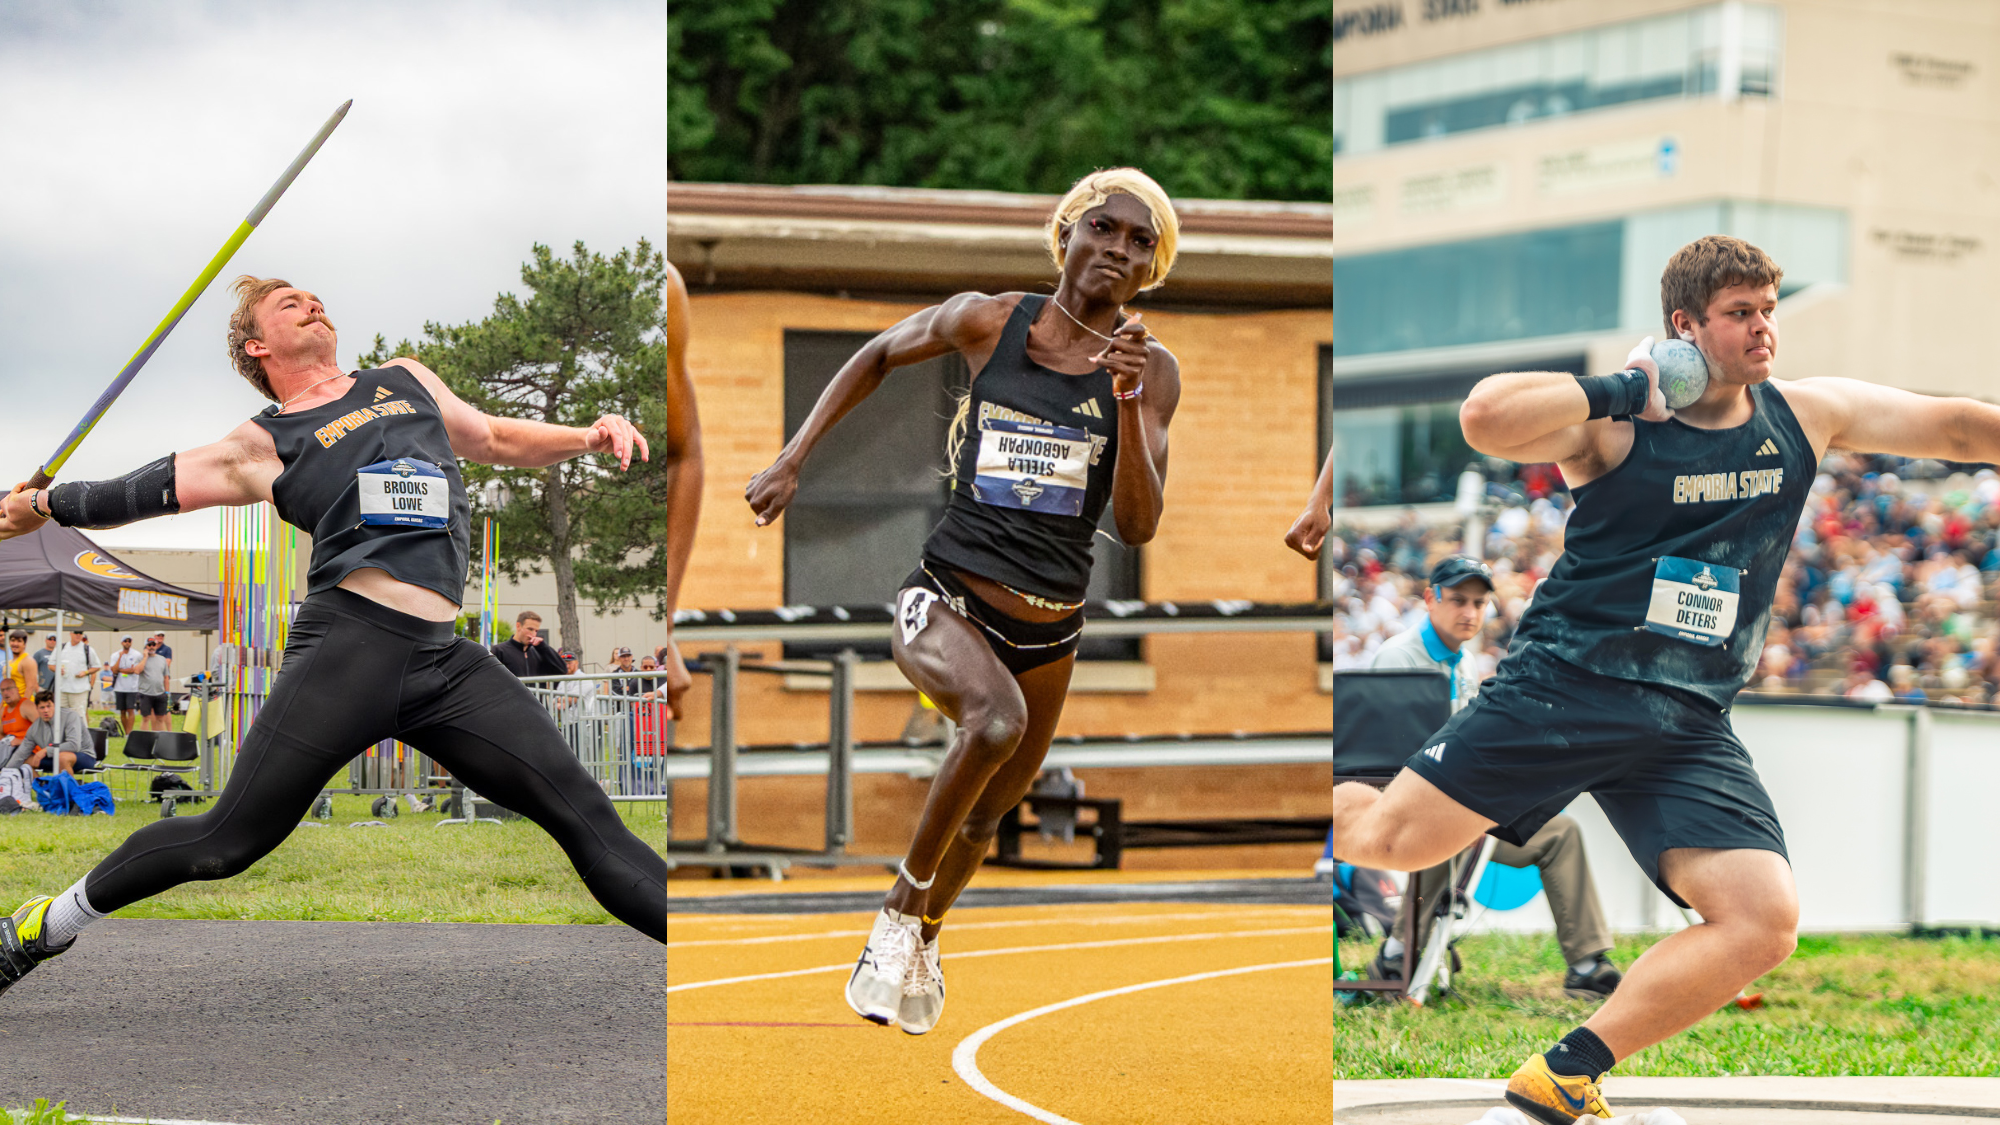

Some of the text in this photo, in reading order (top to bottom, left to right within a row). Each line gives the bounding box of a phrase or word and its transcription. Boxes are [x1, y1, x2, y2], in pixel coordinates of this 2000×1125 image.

[1671, 378, 1686, 395] 18
[314, 400, 417, 449] EMPORIA STATE
[998, 436, 1071, 460] AGBOKPAH
[1008, 457, 1056, 477] STELLA
[384, 481, 428, 495] BROOKS
[1673, 467, 1784, 504] EMPORIA STATE
[392, 497, 423, 511] LOWE
[117, 587, 189, 621] HORNETS
[1677, 591, 1723, 613] CONNOR
[1676, 609, 1717, 630] DETERS
